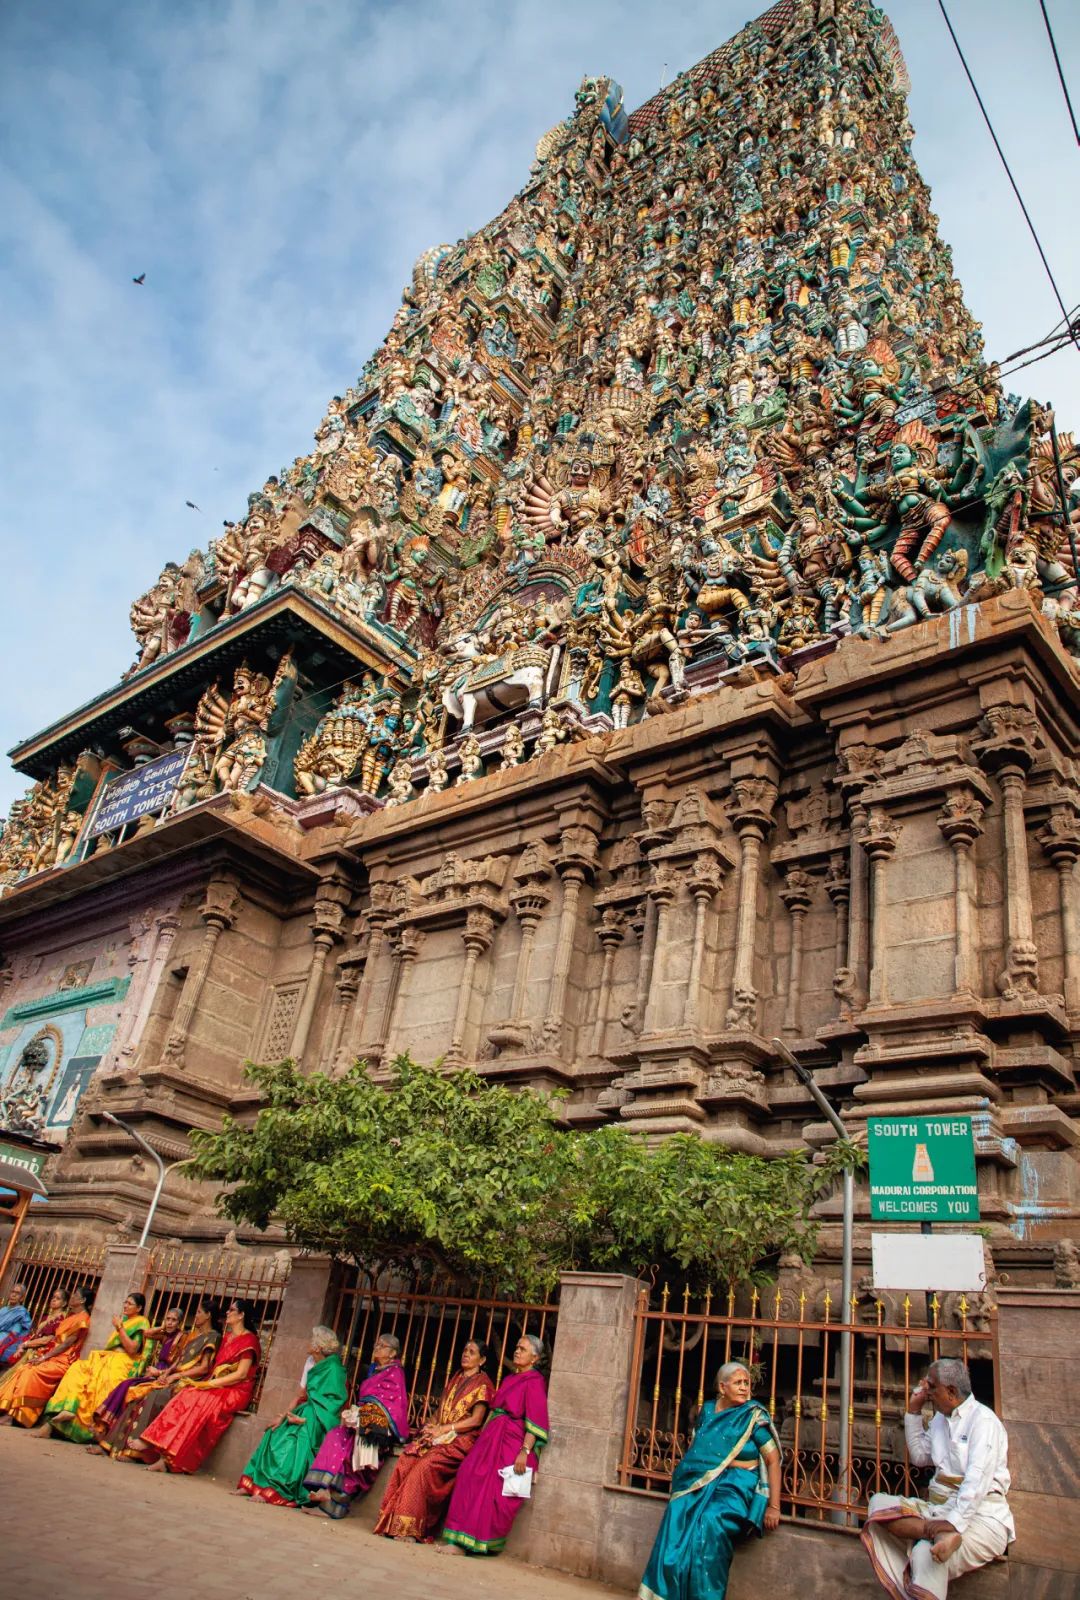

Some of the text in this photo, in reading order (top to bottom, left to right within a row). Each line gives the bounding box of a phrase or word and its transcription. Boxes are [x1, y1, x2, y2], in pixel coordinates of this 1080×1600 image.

[94, 790, 173, 832] SOUTH TOWER
[874, 1123, 968, 1137] SOUTH TOWER
[871, 1185, 977, 1196] MADURAI CORPORATION
[878, 1201, 970, 1214] WELCOMES YOU
